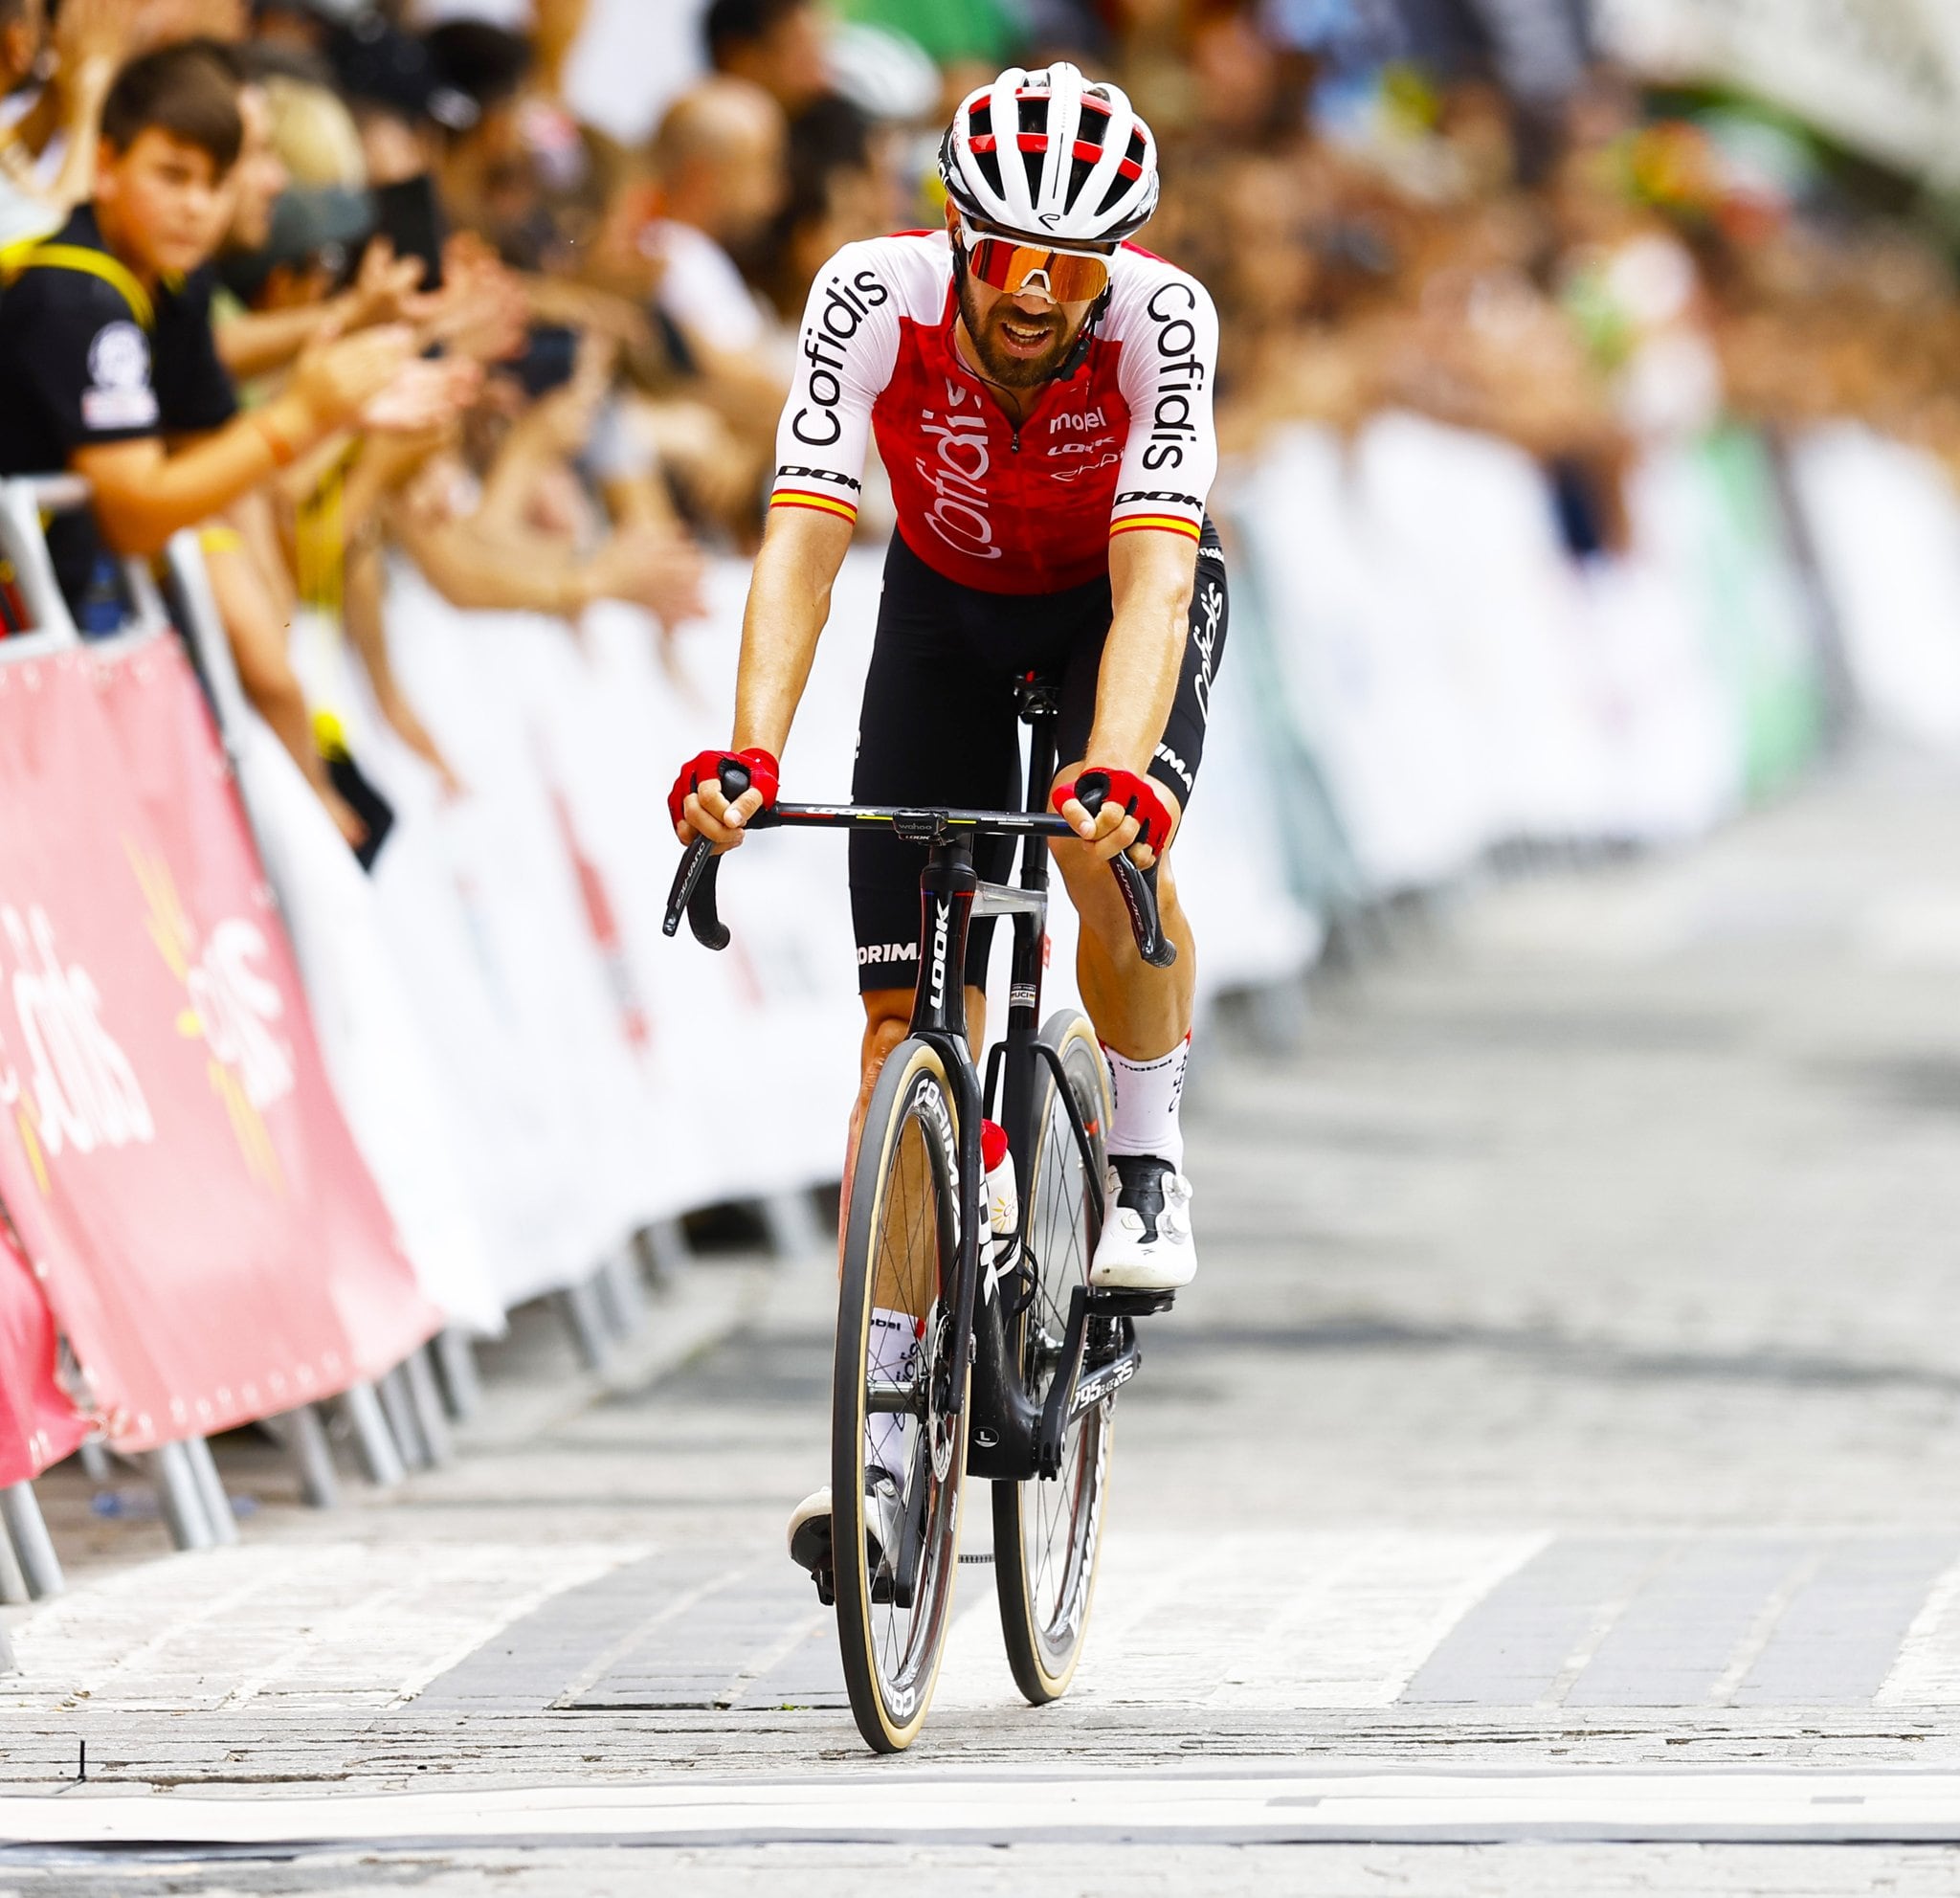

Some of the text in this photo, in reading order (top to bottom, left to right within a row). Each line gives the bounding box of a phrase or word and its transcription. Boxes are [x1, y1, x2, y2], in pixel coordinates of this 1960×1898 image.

[792, 271, 888, 446] Cofidis
[1142, 282, 1204, 470] Cofidis
[930, 898, 950, 1010] LOOK
